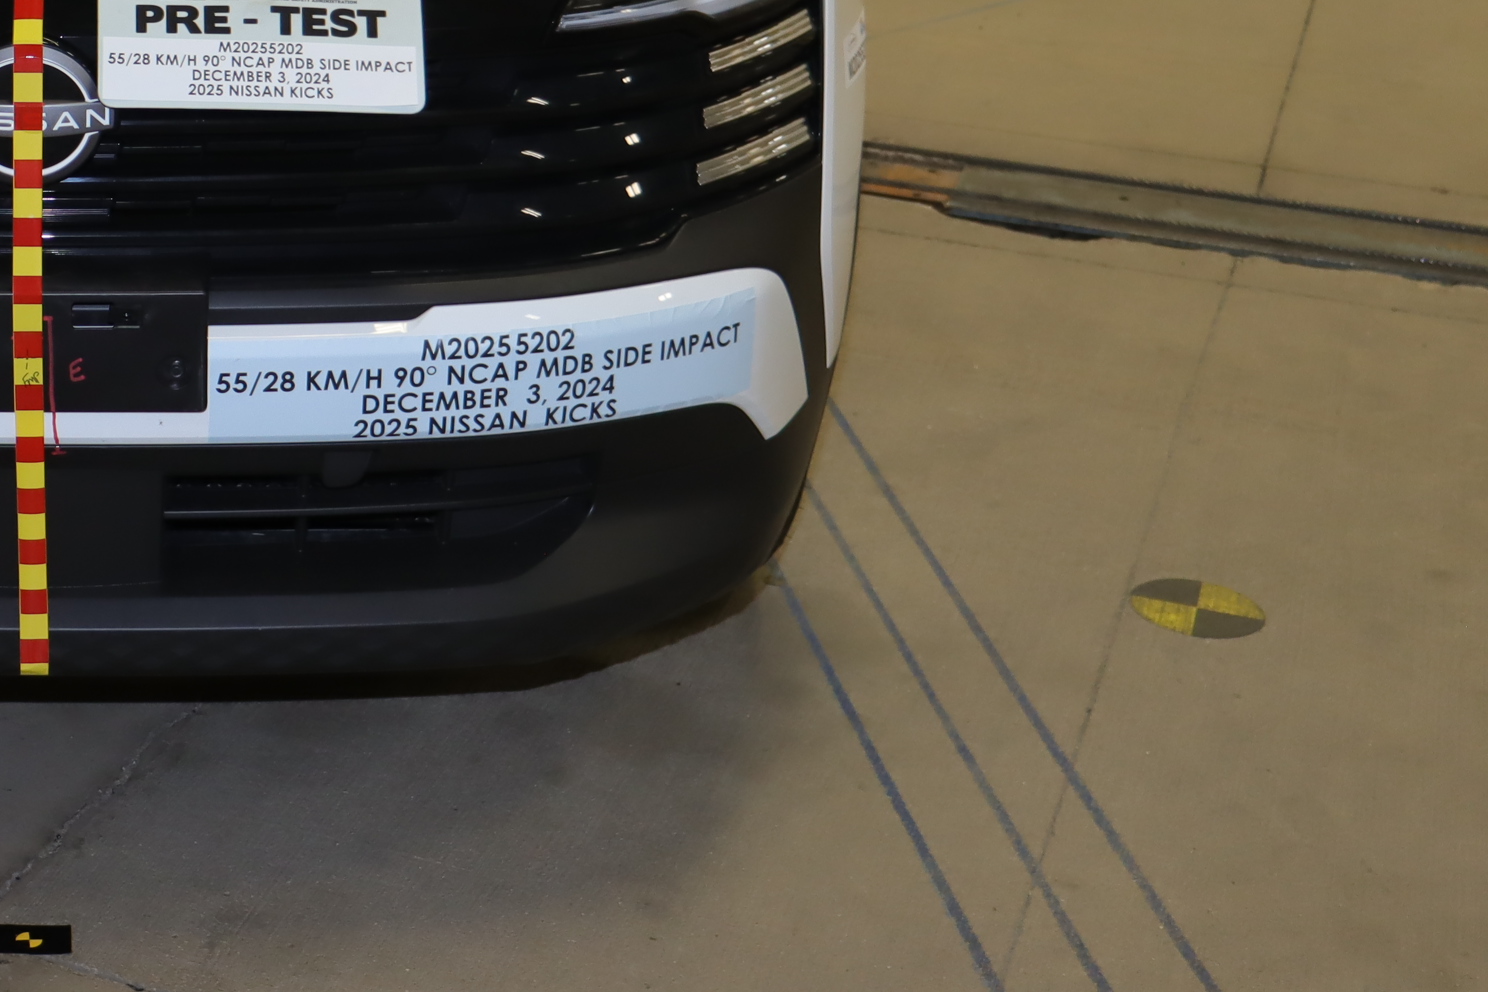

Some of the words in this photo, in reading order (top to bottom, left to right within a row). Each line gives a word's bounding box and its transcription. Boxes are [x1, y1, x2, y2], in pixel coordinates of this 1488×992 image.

[135, 4, 231, 35] PRE
[270, 5, 387, 39] TEST
[107, 52, 151, 66] 55/28
[155, 54, 197, 68] KM/H
[202, 55, 226, 67] 90°
[231, 56, 275, 68] NCAP
[280, 57, 314, 69] MDB
[319, 58, 351, 71] SIDE
[356, 60, 413, 73] IMPACT
[218, 41, 303, 55] M20255202
[188, 84, 224, 96] 2025
[229, 85, 284, 98] NISSAN
[289, 86, 334, 99] KICKS
[192, 69, 272, 83] DECEMBER
[277, 71, 290, 85] 3,
[295, 72, 330, 85] 2024
[215, 370, 296, 396] 55/28
[306, 368, 383, 394] KM/H
[393, 365, 437, 388] 90°
[447, 360, 528, 386] NCAP
[536, 353, 593, 379] MDB
[602, 343, 653, 370] SIDE
[660, 322, 741, 361] IMPACT
[421, 328, 575, 361] M20255202
[69, 357, 86, 383] E
[362, 387, 508, 415] DECEMBER
[526, 384, 547, 406] 3,
[556, 374, 615, 402] 2024
[352, 417, 418, 438] 2025
[428, 410, 527, 435] NISSAN
[544, 398, 617, 426] KICKS
